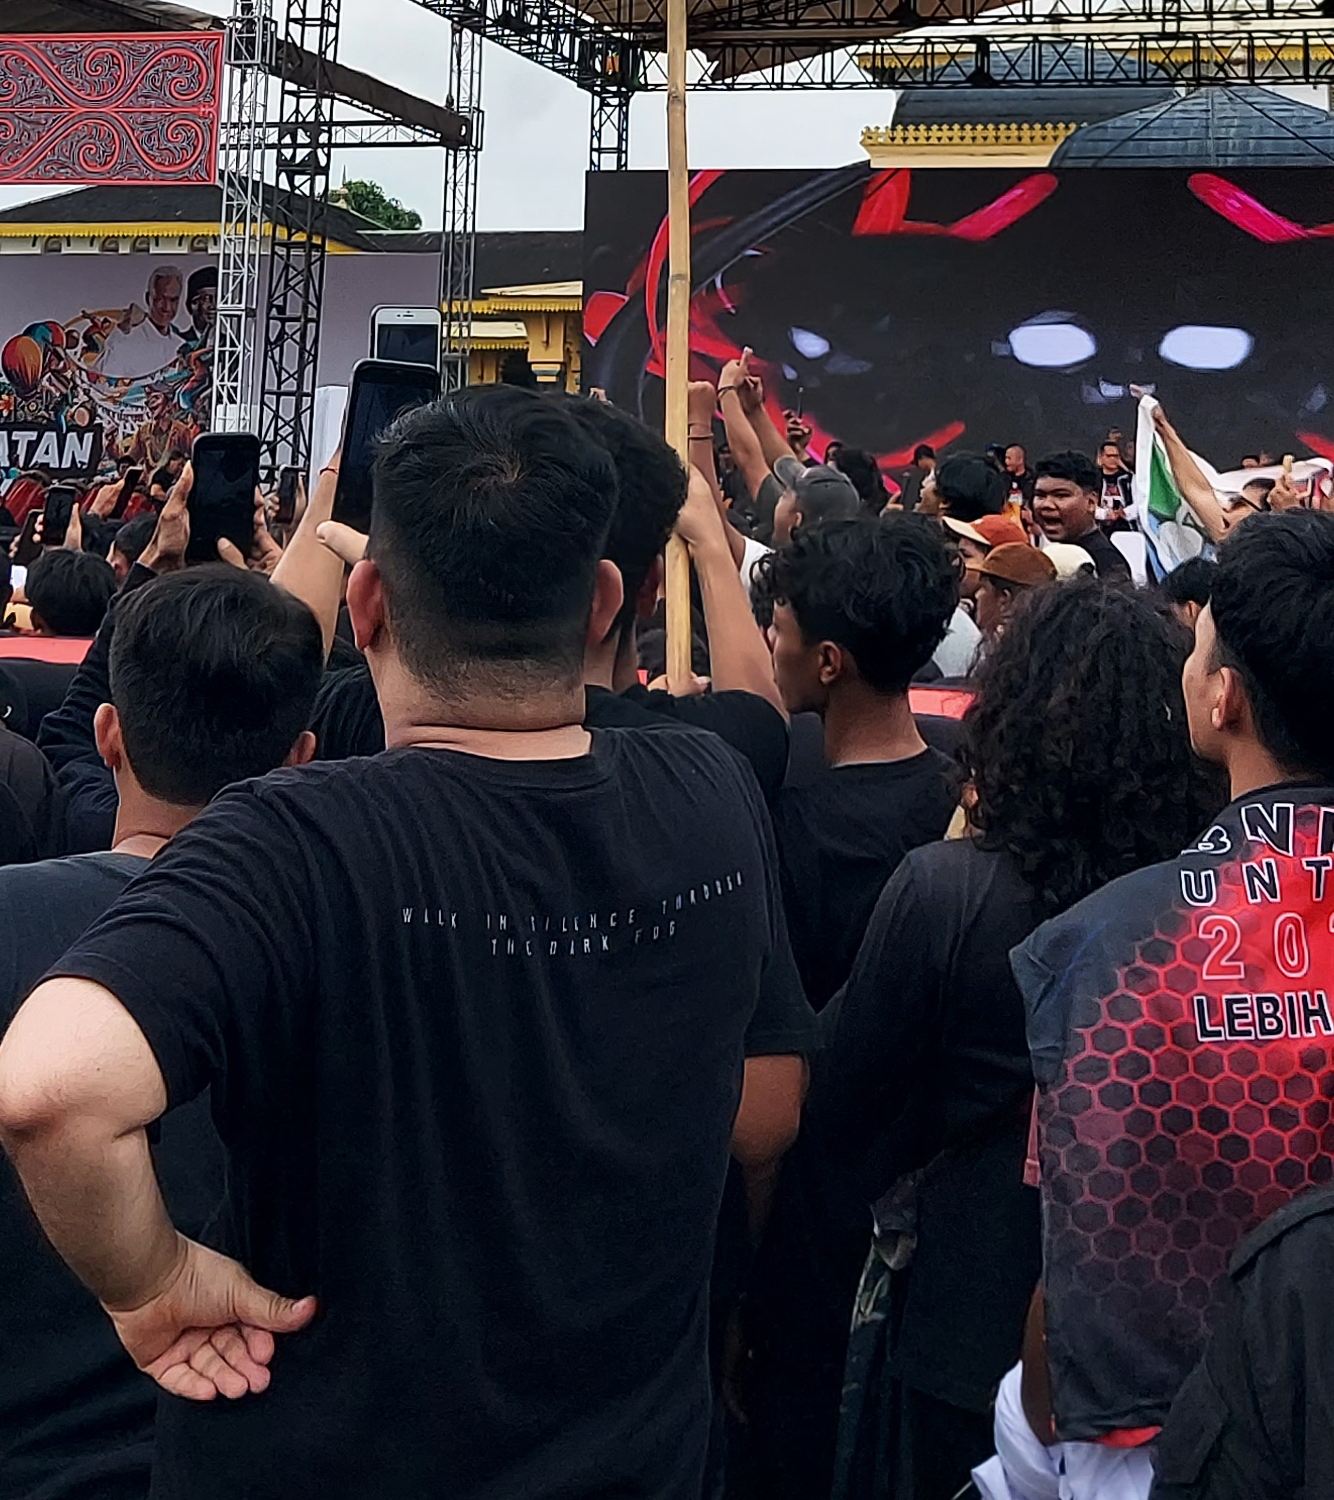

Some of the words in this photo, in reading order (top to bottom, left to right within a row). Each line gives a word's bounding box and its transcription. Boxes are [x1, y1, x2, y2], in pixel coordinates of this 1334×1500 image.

[402, 907, 457, 929] WALK
[529, 908, 636, 933] SILENCE
[490, 938, 534, 957] THE
[548, 932, 610, 956] DARK
[633, 920, 676, 944] FOG
